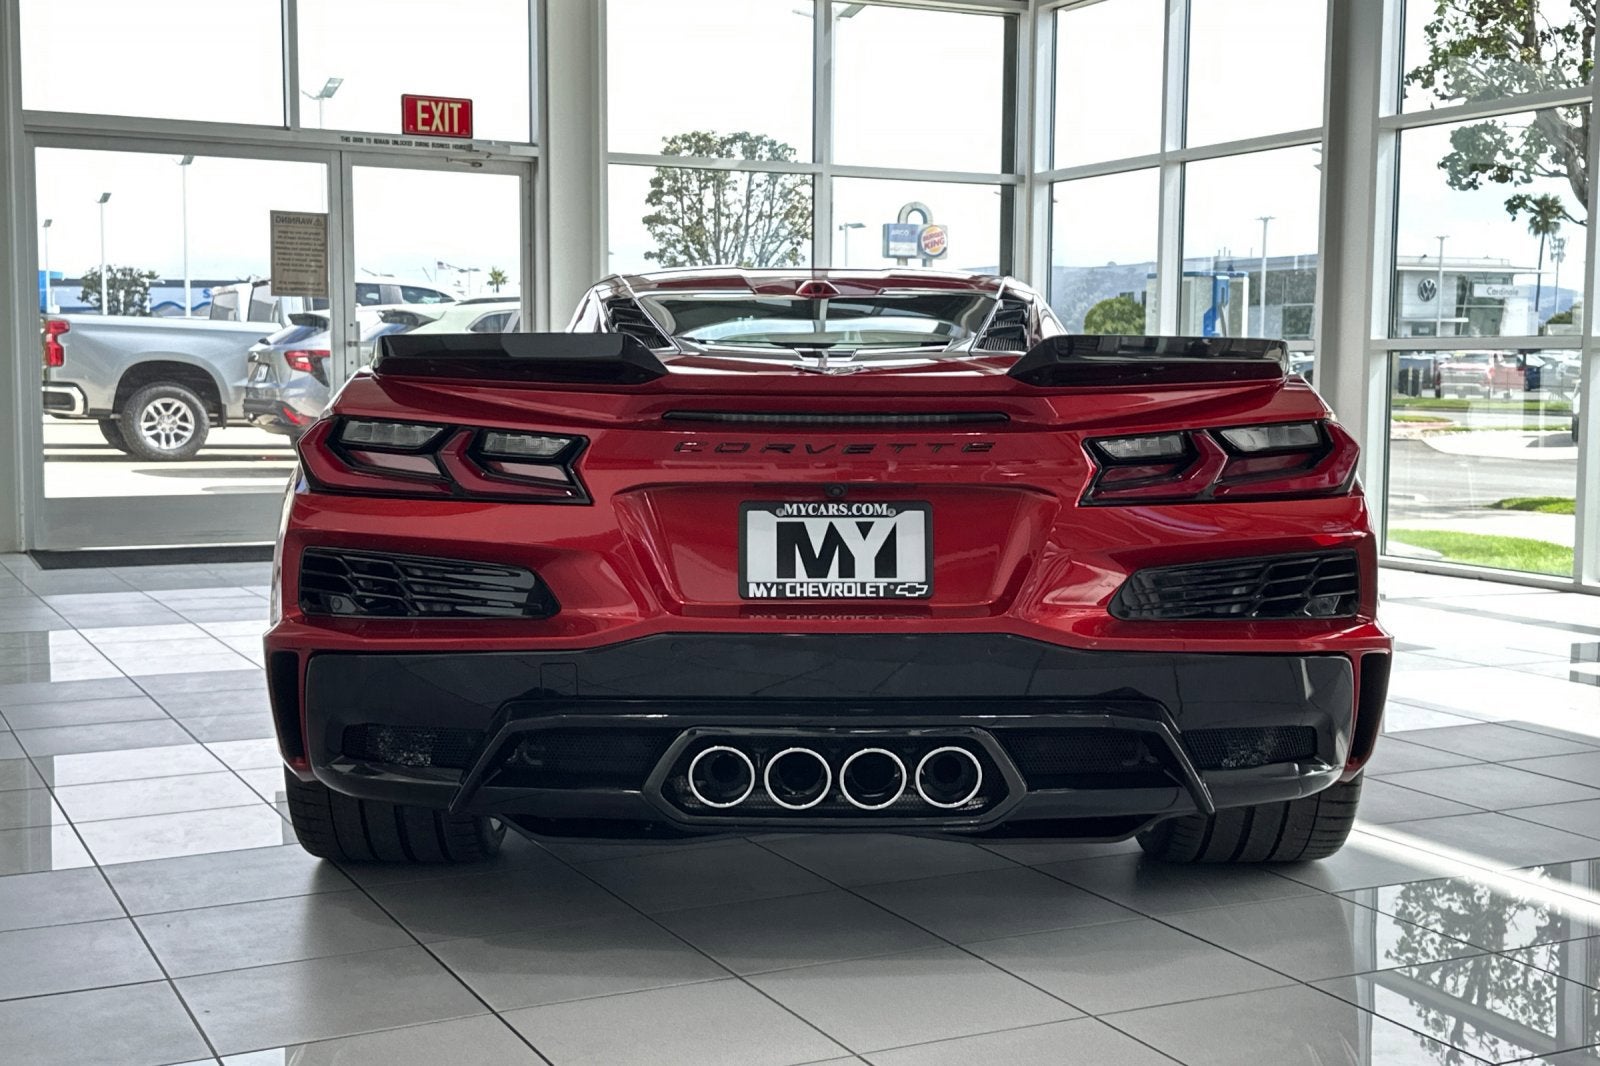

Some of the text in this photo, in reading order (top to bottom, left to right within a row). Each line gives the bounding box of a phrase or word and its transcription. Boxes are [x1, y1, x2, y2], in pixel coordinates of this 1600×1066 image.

[416, 100, 462, 133] EXIT
[391, 139, 413, 147] UNLOCKED
[924, 237, 945, 250] KING
[1486, 286, 1519, 296] Cardinale
[673, 440, 997, 455] CORVETTE
[783, 503, 888, 516] MYCARS.COM
[776, 521, 898, 579] MY
[748, 582, 888, 598] MY CHEVROLET
